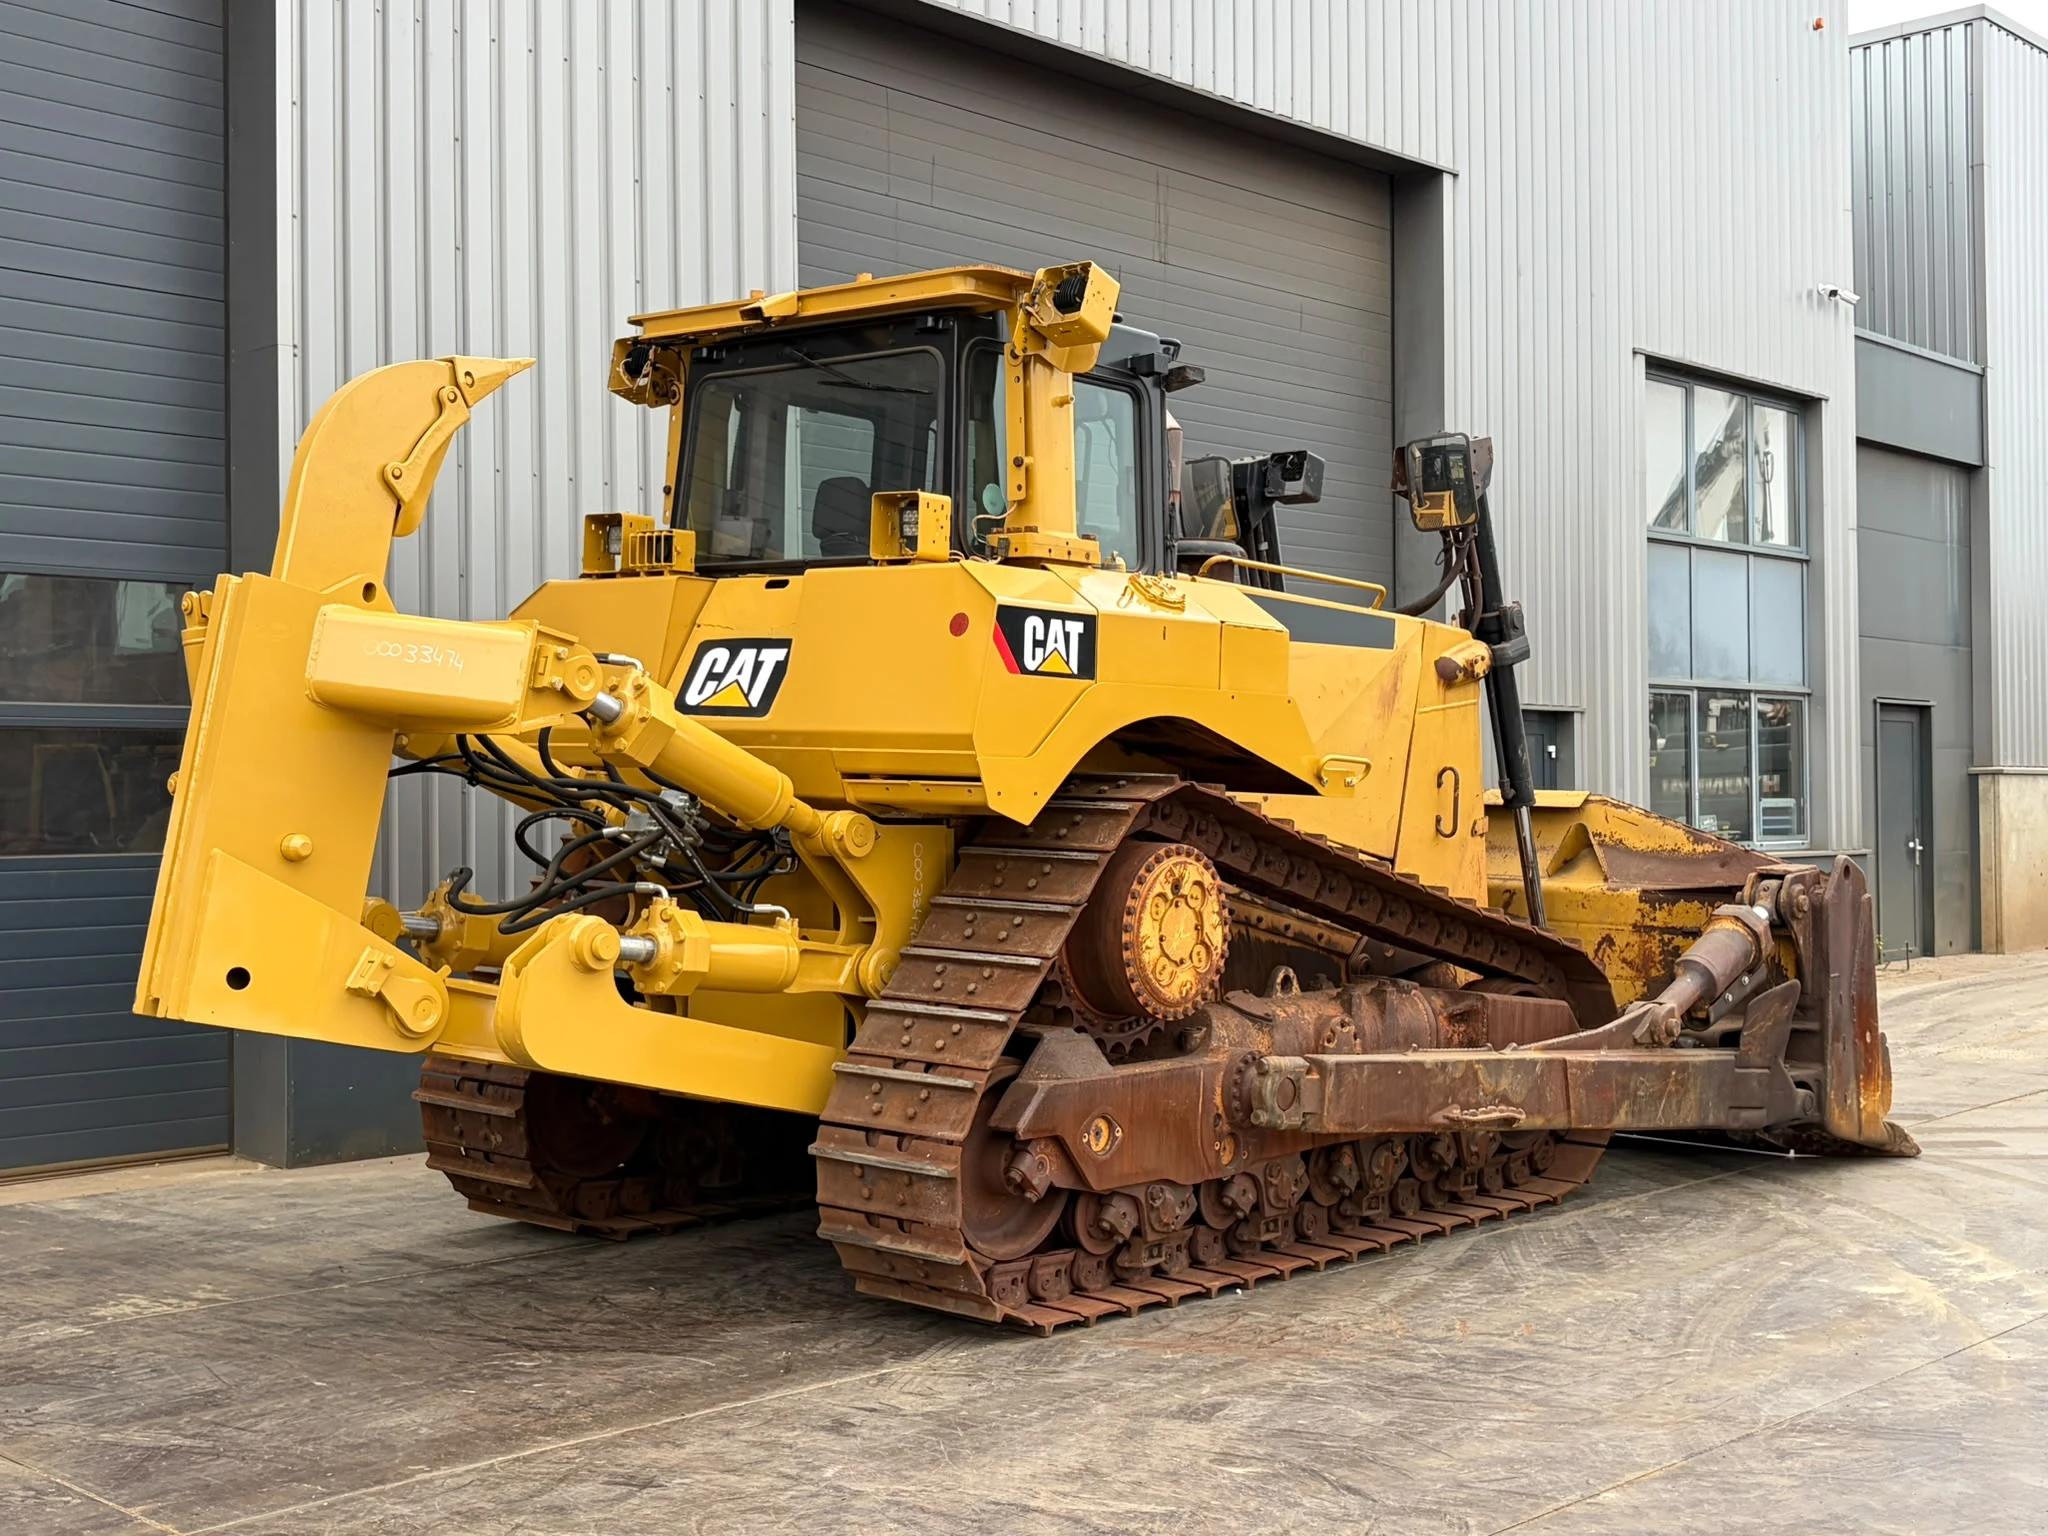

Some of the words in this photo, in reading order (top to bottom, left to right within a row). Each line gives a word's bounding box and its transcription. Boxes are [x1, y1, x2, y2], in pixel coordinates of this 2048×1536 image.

[363, 640, 464, 676] 00033474
[1023, 615, 1084, 675] CAT
[685, 647, 788, 708] CAT
